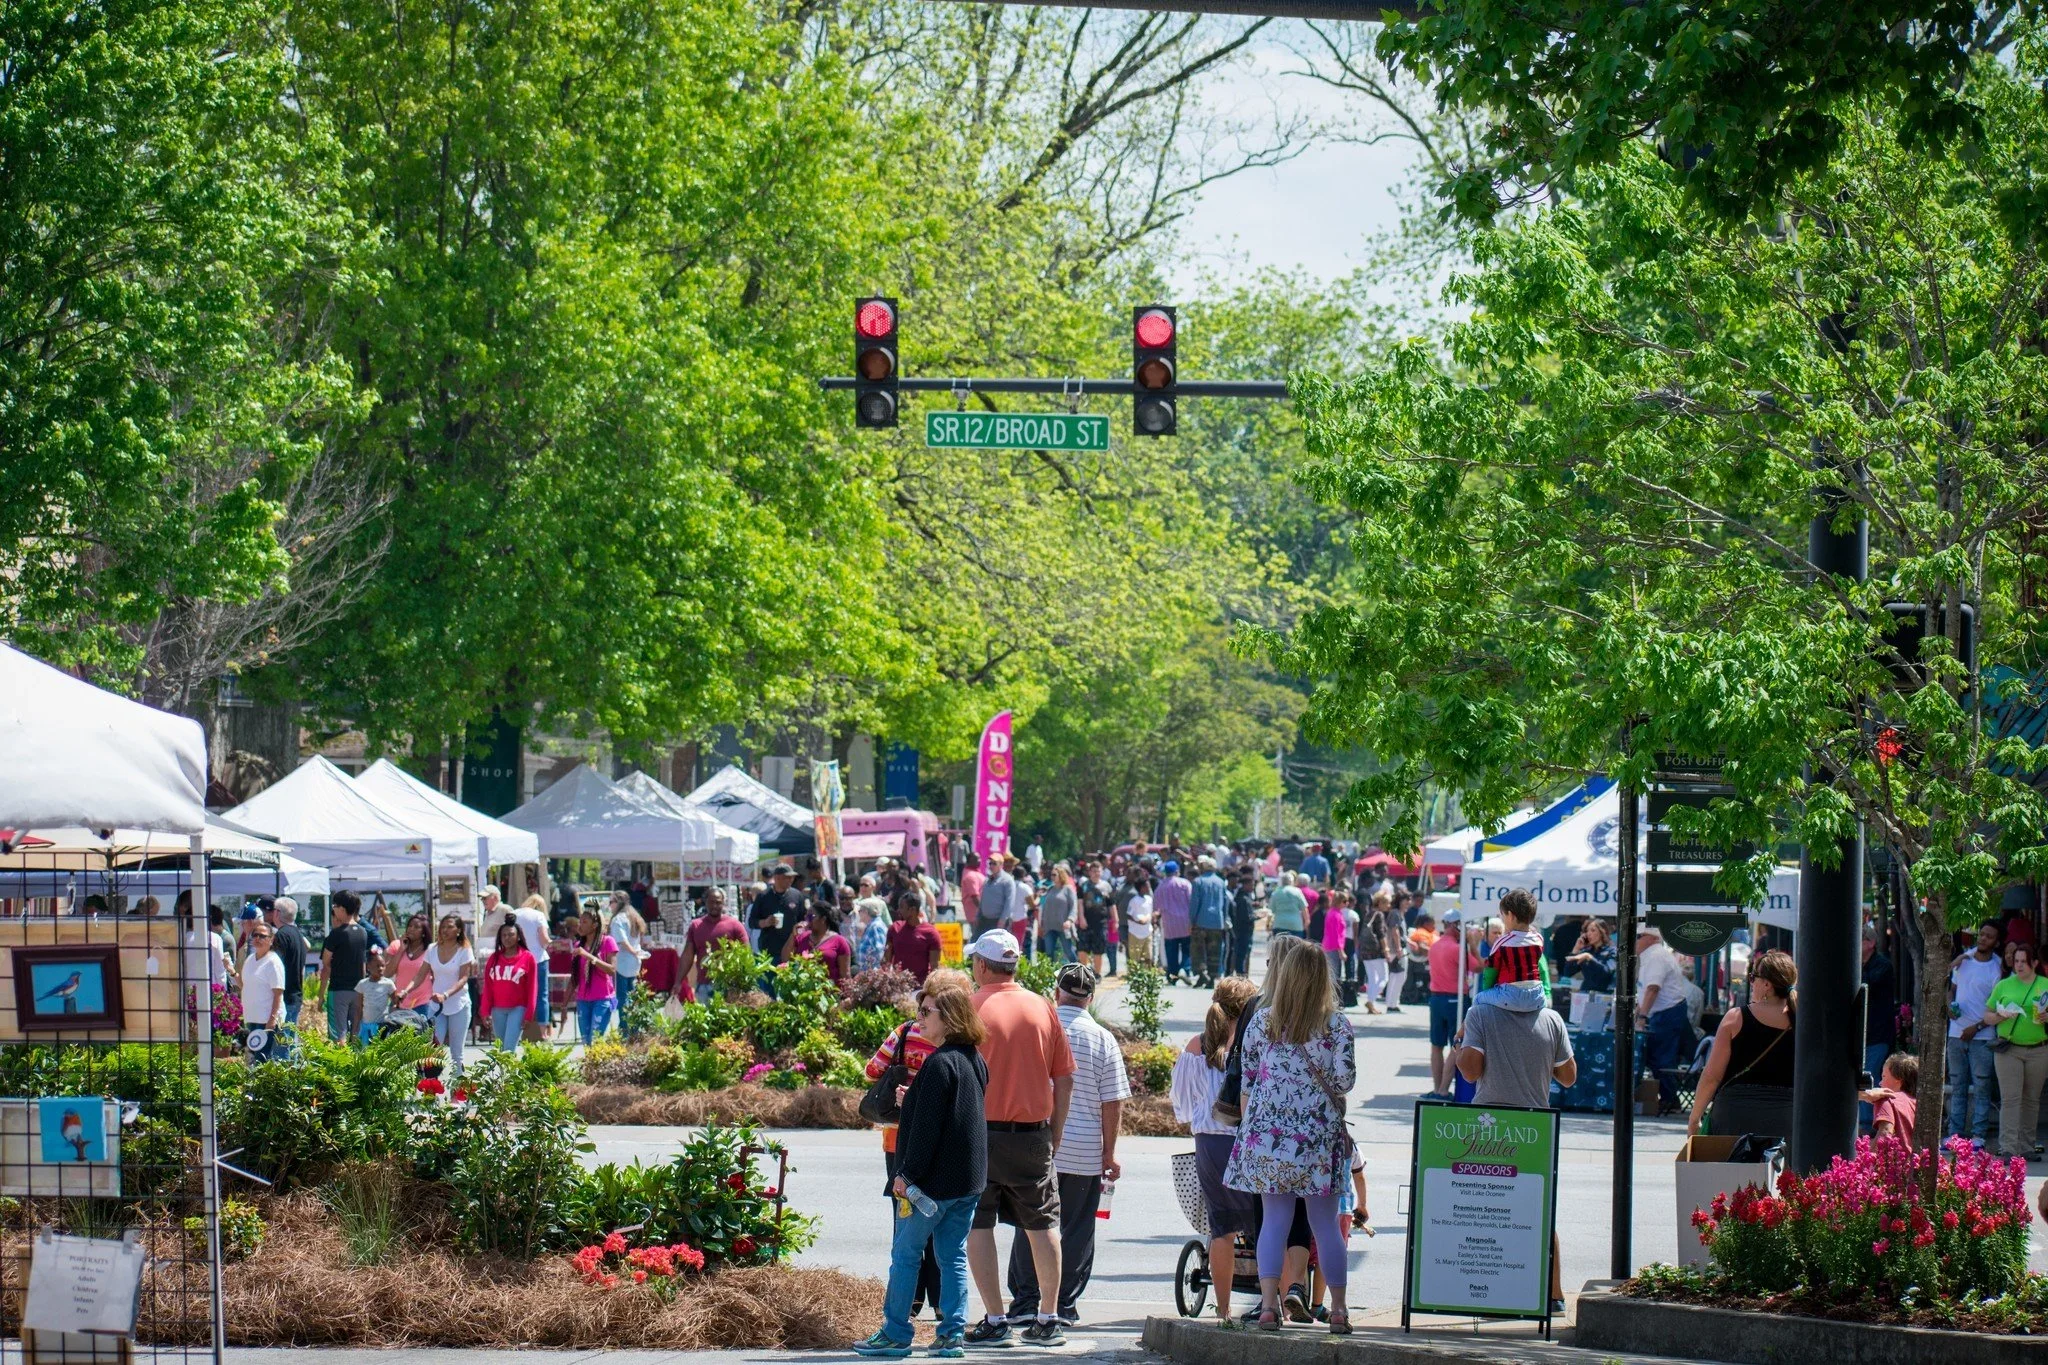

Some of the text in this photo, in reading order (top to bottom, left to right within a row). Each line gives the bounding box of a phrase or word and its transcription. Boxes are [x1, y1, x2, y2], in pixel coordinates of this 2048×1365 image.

[931, 418, 1105, 447] SR.12/BROAD ST.
[1695, 756, 1728, 767] OFFIC
[470, 766, 514, 778] SHOP
[1669, 850, 1723, 860] TREASURES
[1434, 1121, 1539, 1144] SOUTHLAND
[1445, 1131, 1518, 1160] Jubilee
[1457, 1163, 1512, 1176] SPONSORS
[1451, 1180, 1515, 1191] Presenting Sponsor
[1453, 1204, 1511, 1214] Premium Sponsor
[1453, 1212, 1476, 1220] Reynolds
[1465, 1236, 1496, 1244] Magnolia
[1503, 1262, 1525, 1270] Hospital
